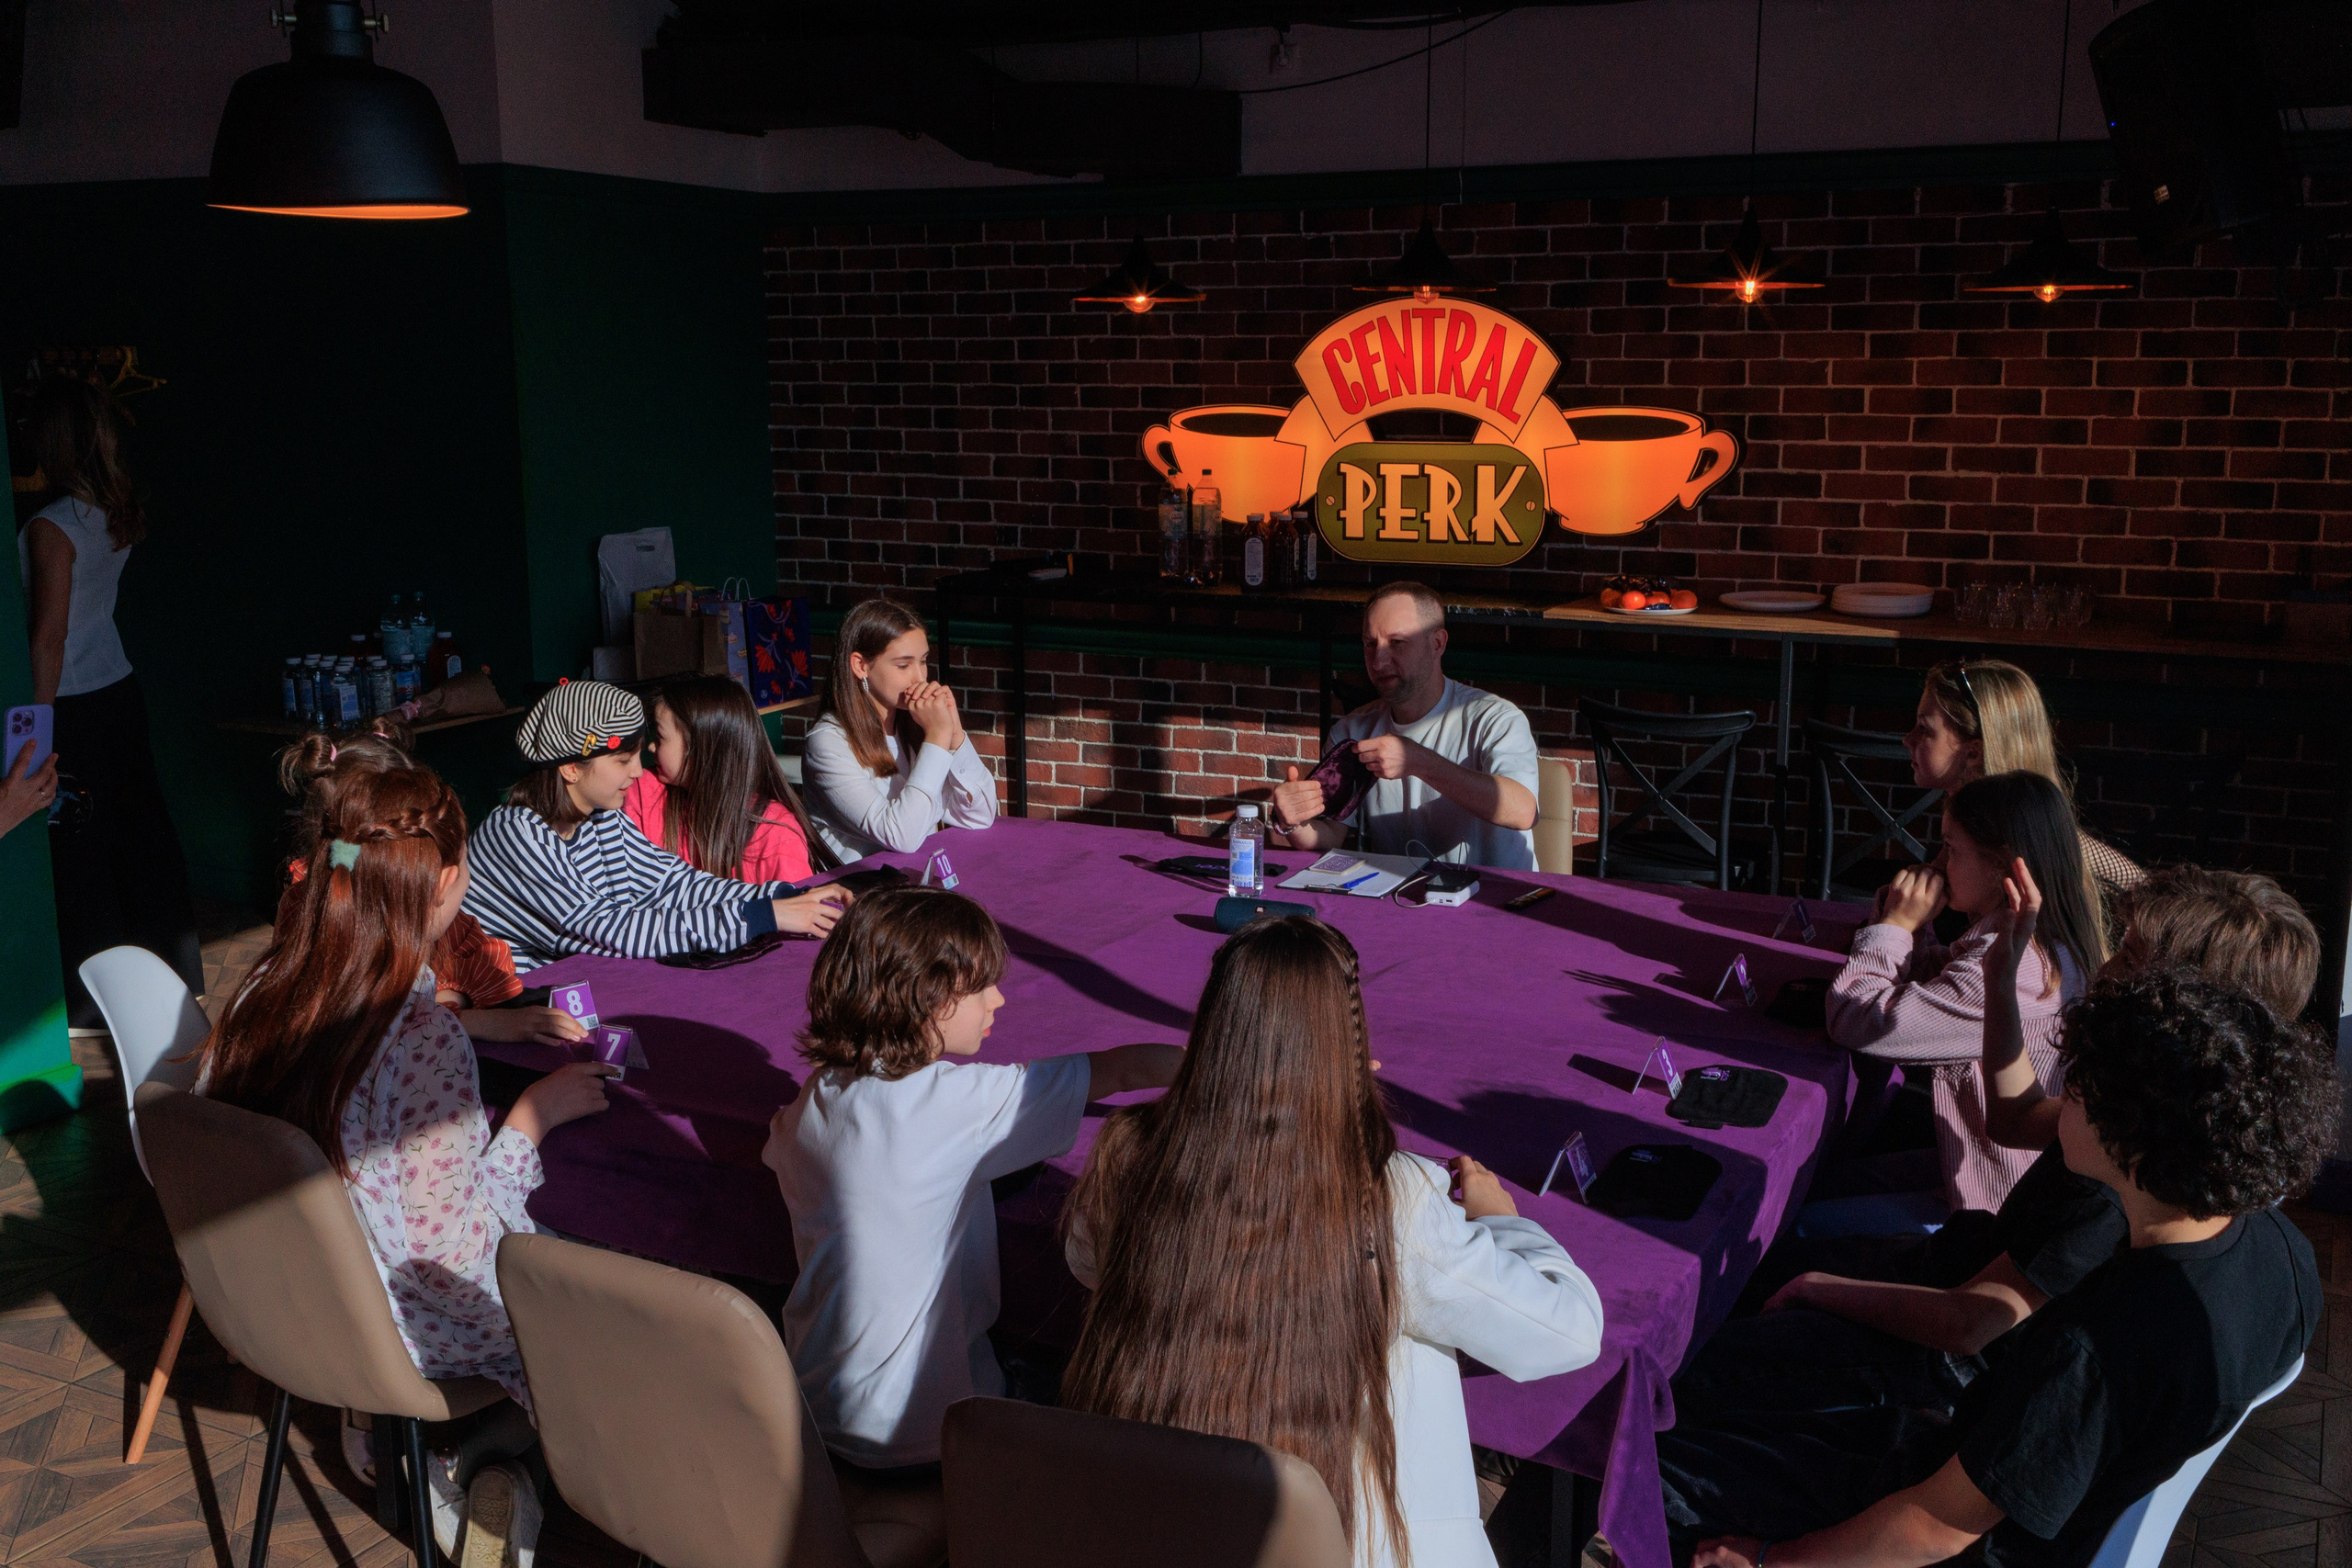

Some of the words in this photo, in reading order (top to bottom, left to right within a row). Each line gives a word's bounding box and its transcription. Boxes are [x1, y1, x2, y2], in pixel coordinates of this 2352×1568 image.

[1321, 307, 1539, 425] CENTRAL
[1338, 462, 1530, 546] PERK
[937, 854, 953, 877] 10
[566, 989, 583, 1016] 8
[605, 1032, 621, 1061] 7
[1661, 1048, 1674, 1077] 3
